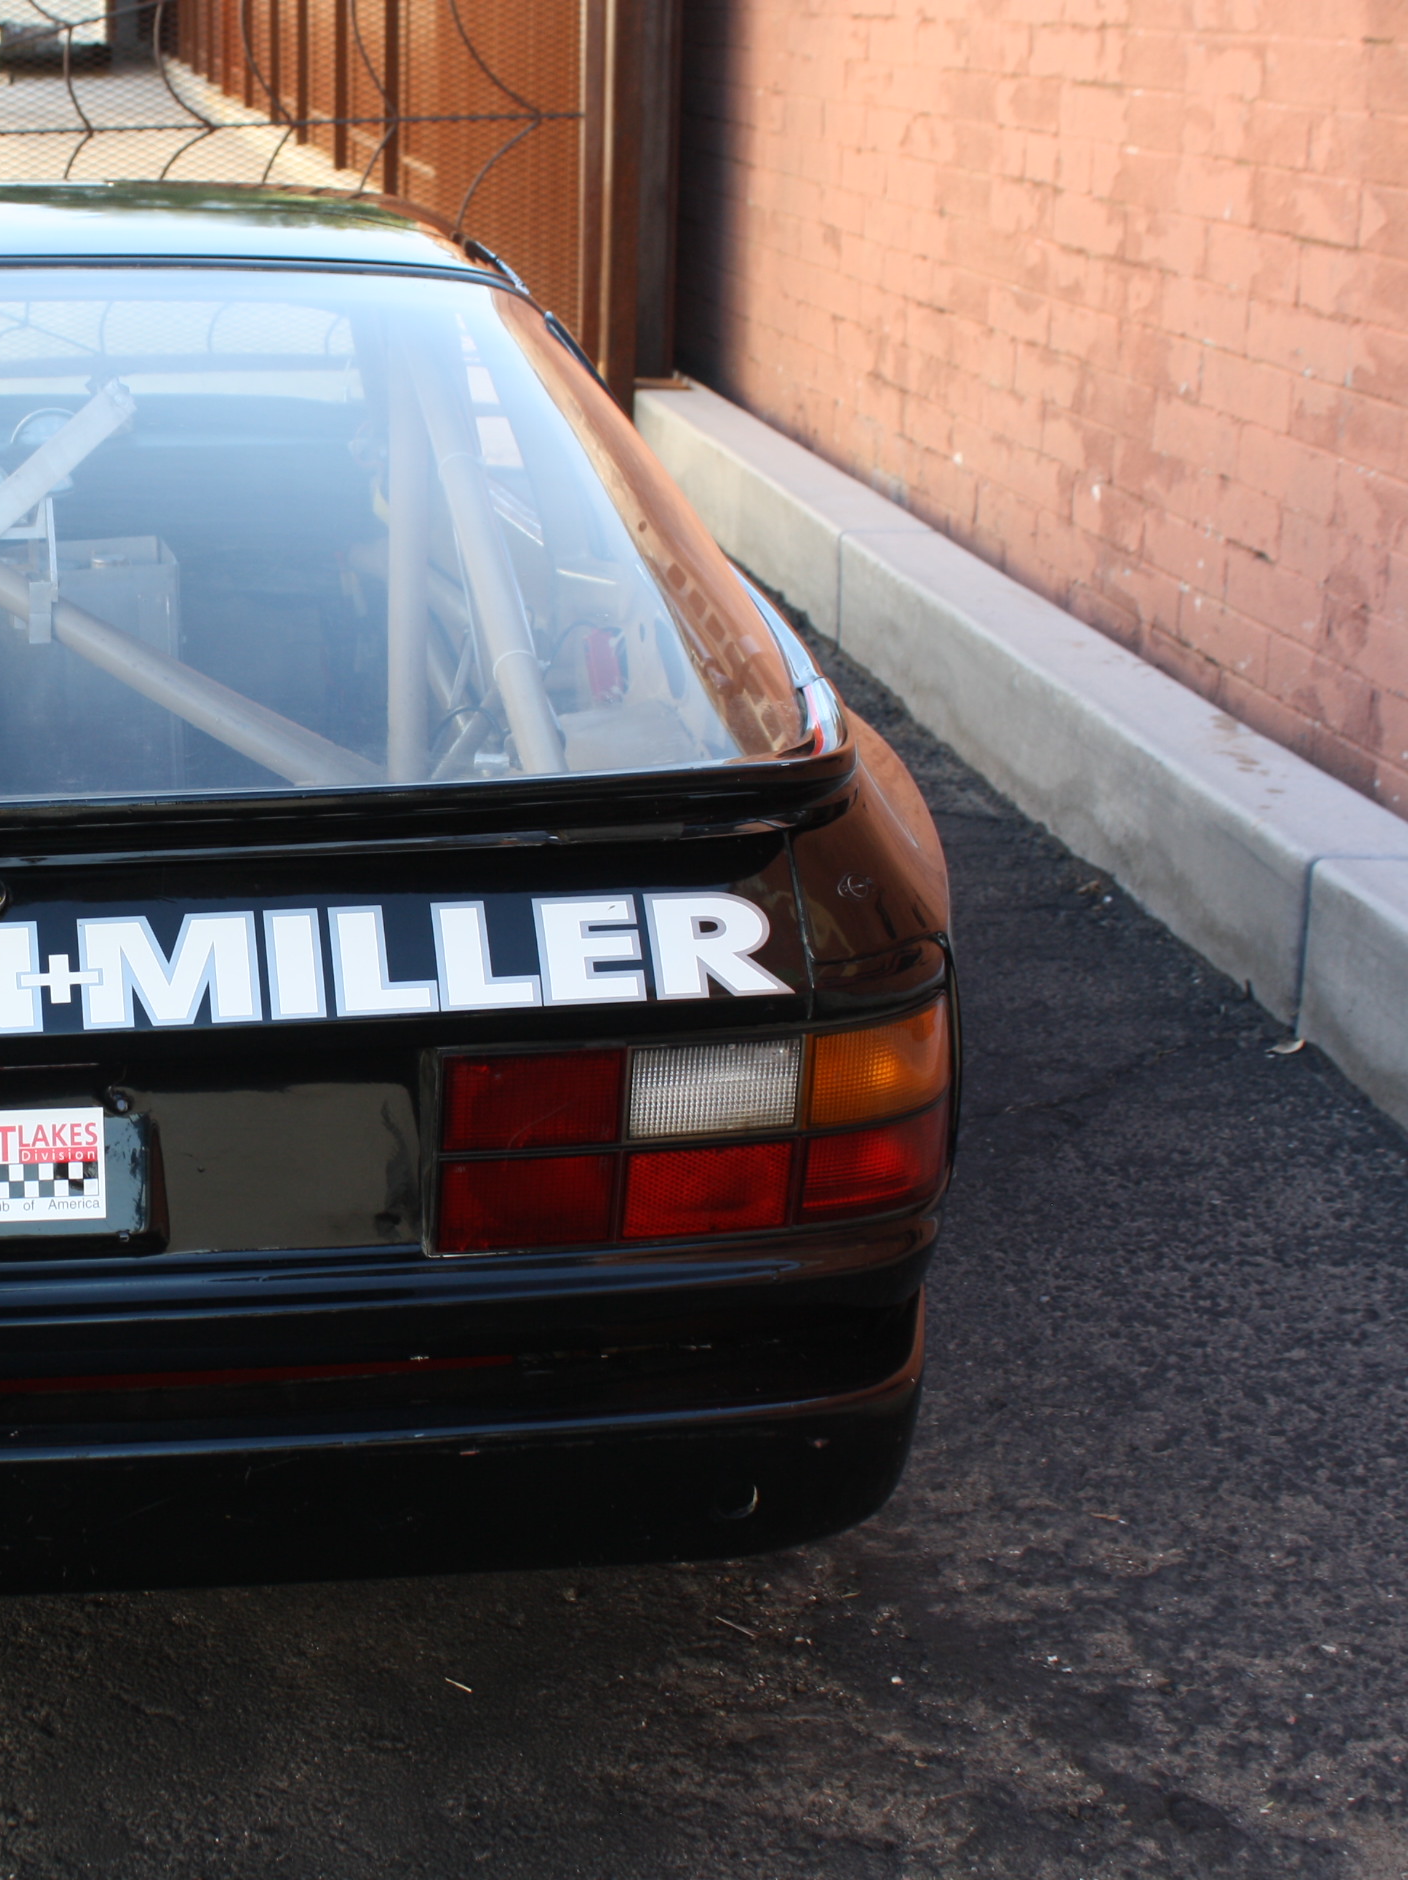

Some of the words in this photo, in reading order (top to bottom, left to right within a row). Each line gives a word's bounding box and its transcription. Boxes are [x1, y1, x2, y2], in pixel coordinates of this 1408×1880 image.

[21, 1149, 95, 1162] Division
[23, 1200, 35, 1211] of
[48, 1198, 100, 1210] America
